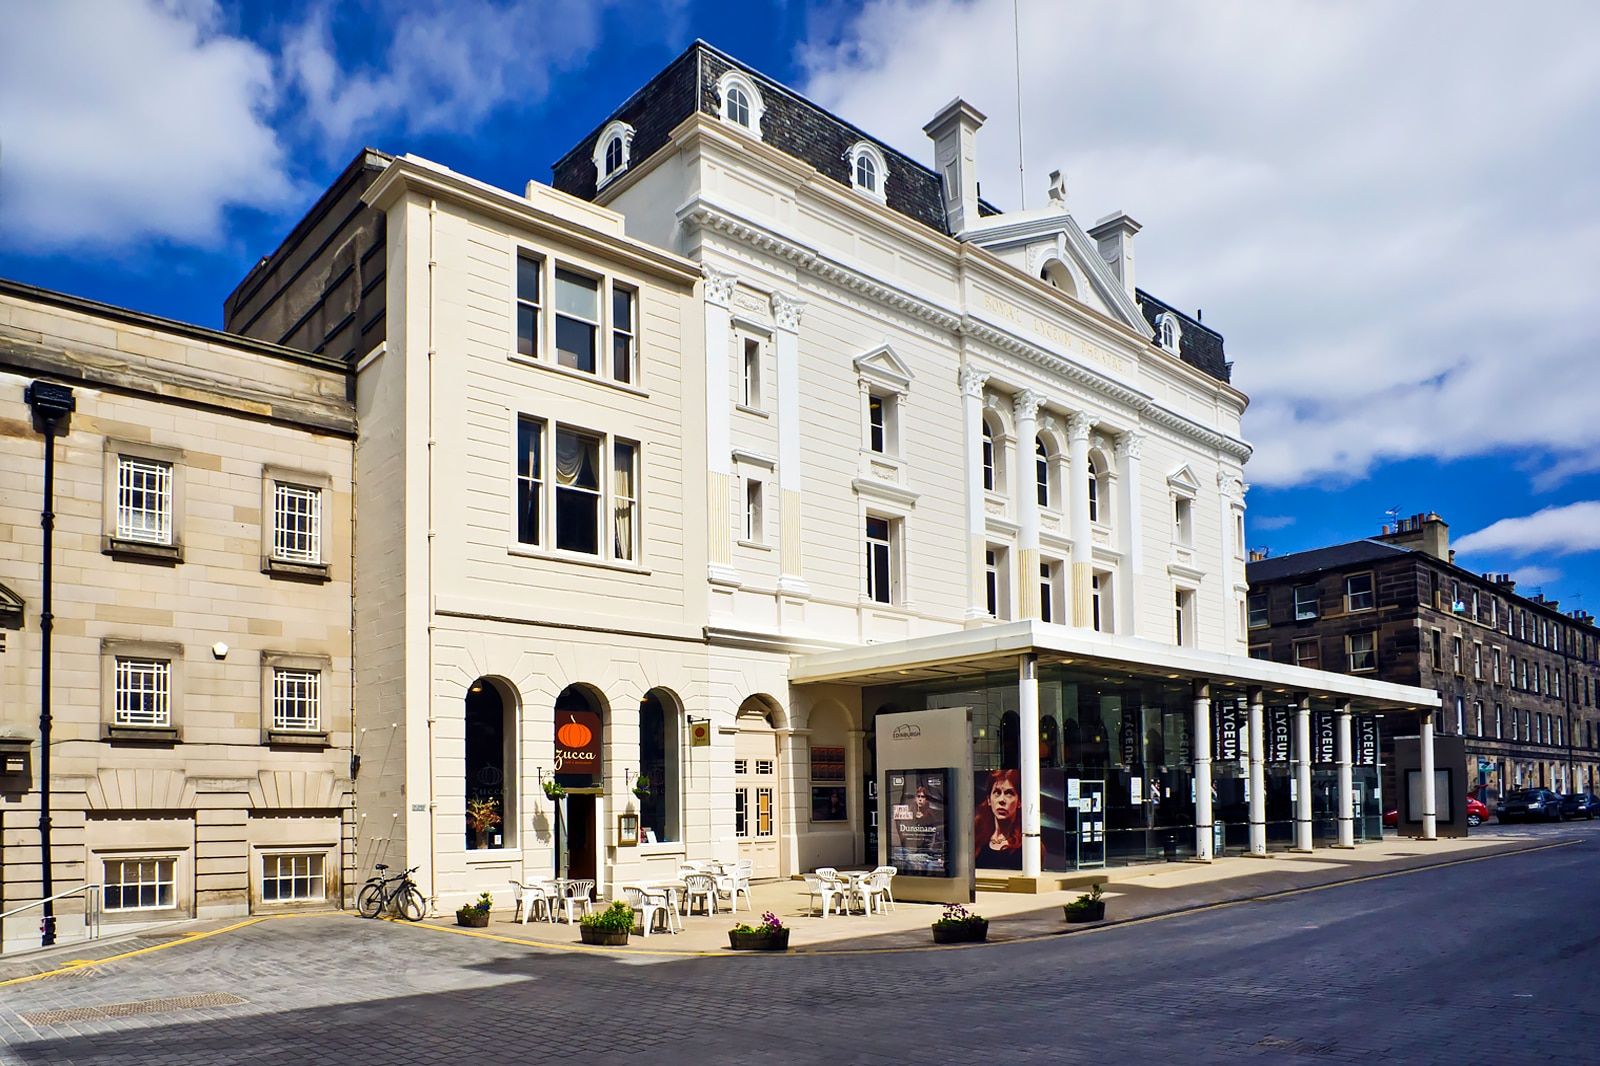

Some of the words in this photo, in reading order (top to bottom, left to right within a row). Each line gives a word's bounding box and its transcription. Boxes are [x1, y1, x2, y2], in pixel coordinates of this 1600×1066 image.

[892, 731, 921, 739] EDINBURGH
[1223, 706, 1236, 760] LYCEUM
[1275, 712, 1288, 761] LYCEUM
[1321, 716, 1333, 763] LYCEUM
[1362, 721, 1374, 765] LYCEUM
[554, 749, 597, 771] zucca
[900, 824, 937, 833] Dunsinane
